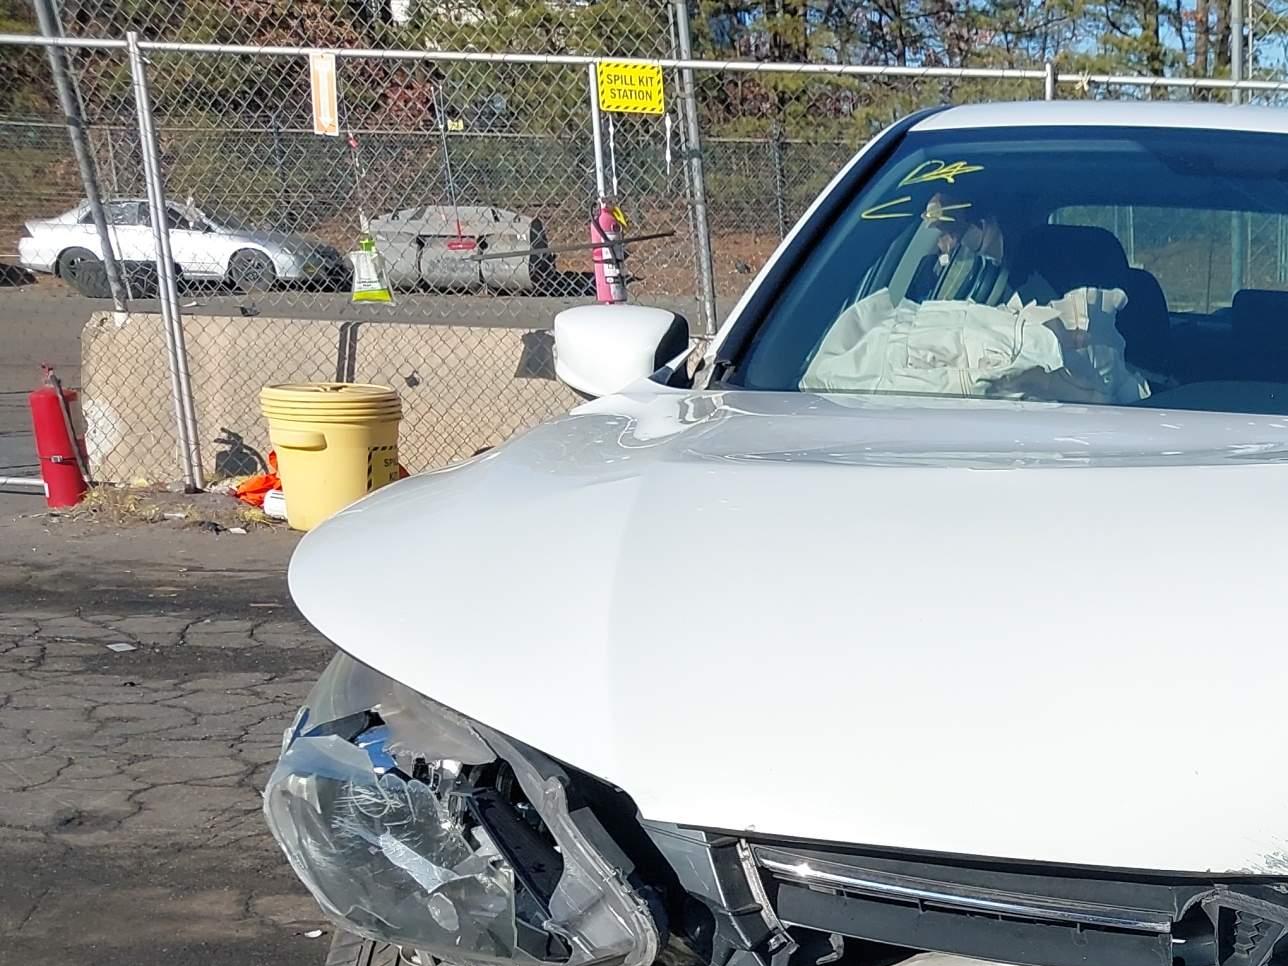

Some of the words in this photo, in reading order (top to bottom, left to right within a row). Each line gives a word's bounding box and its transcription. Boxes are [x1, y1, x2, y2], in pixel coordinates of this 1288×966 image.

[606, 74, 635, 86] SPILL
[638, 76, 654, 87] KIT
[610, 88, 652, 101] STATION
